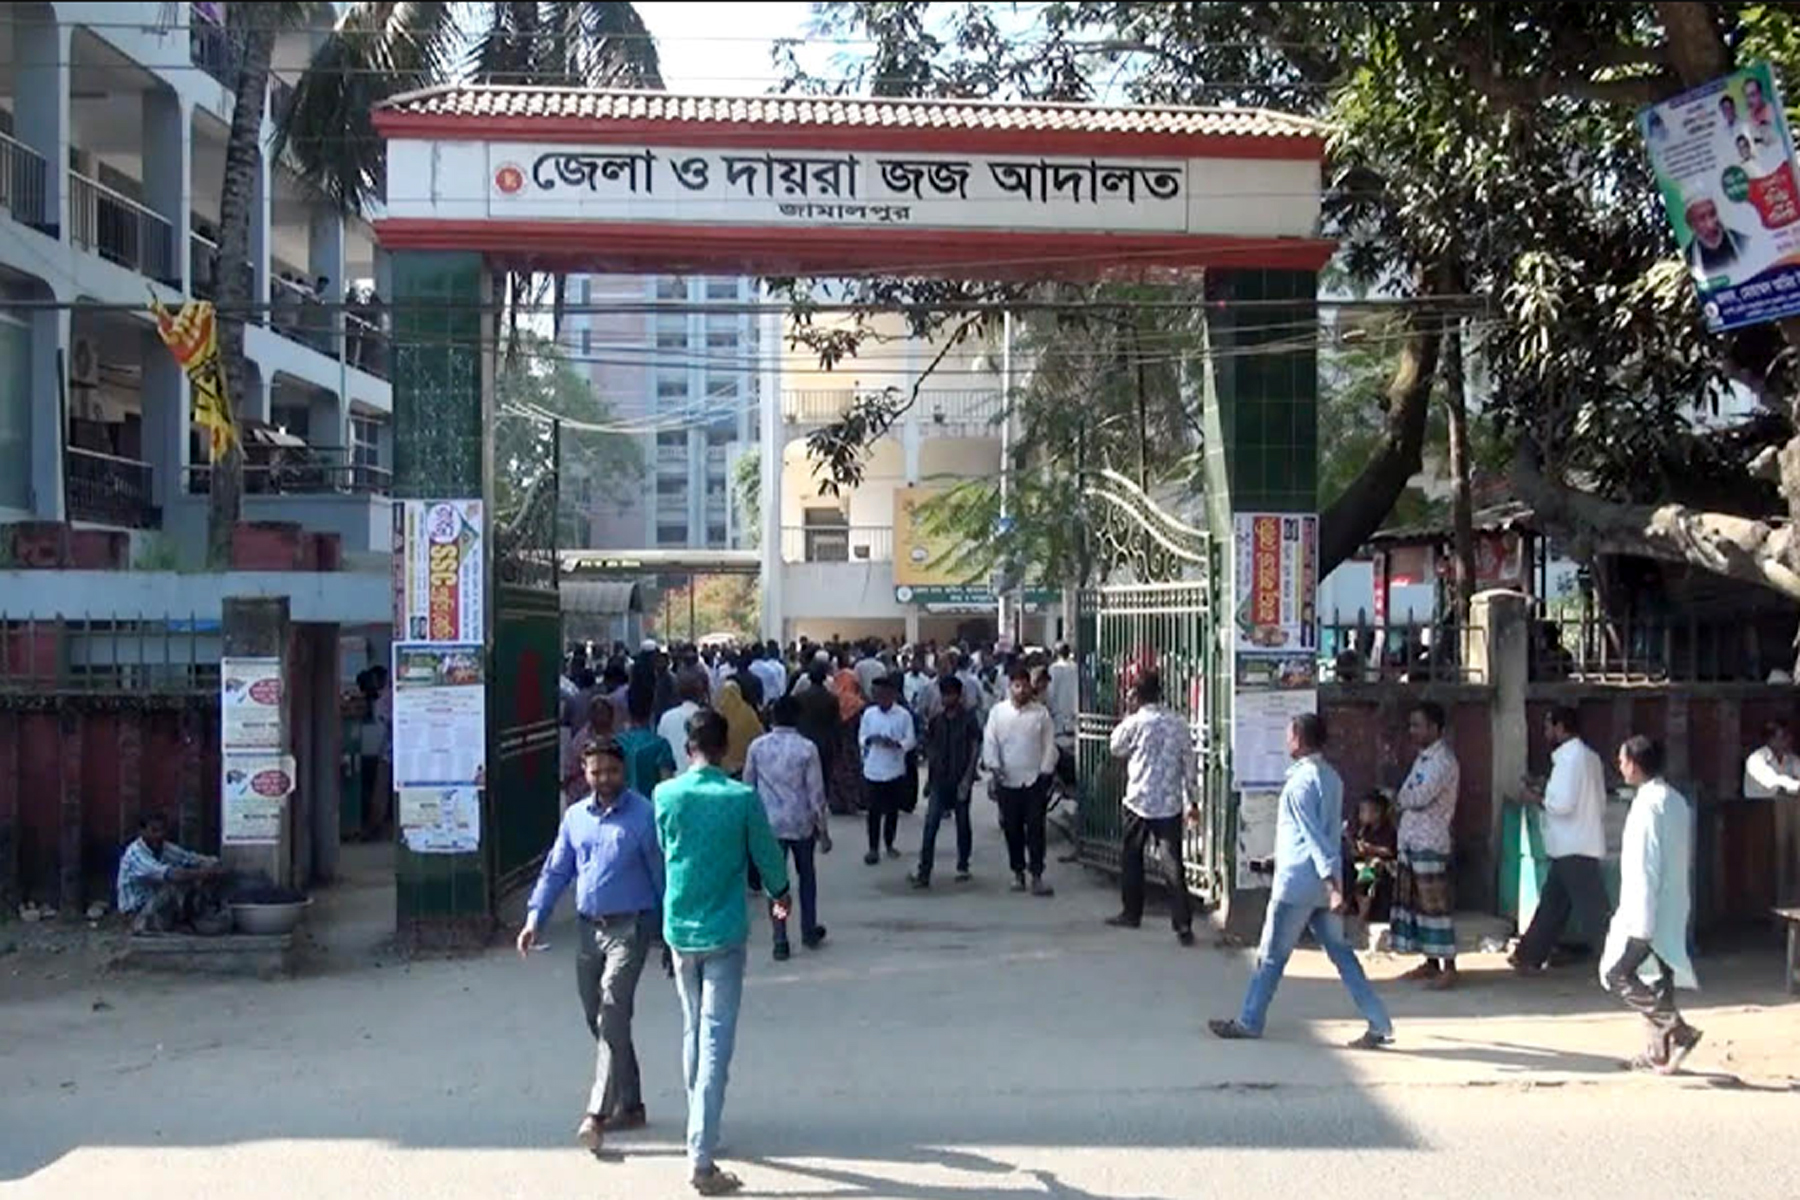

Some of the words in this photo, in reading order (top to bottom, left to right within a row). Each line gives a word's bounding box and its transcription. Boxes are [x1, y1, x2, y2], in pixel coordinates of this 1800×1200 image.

[532, 149, 657, 194] জেলা
[669, 157, 709, 191] ও
[721, 153, 860, 199] দায়রা
[876, 159, 971, 200] জজ
[987, 158, 1183, 204] আদালত
[779, 203, 910, 222] জামালপুর
[430, 544, 459, 586] SSC
